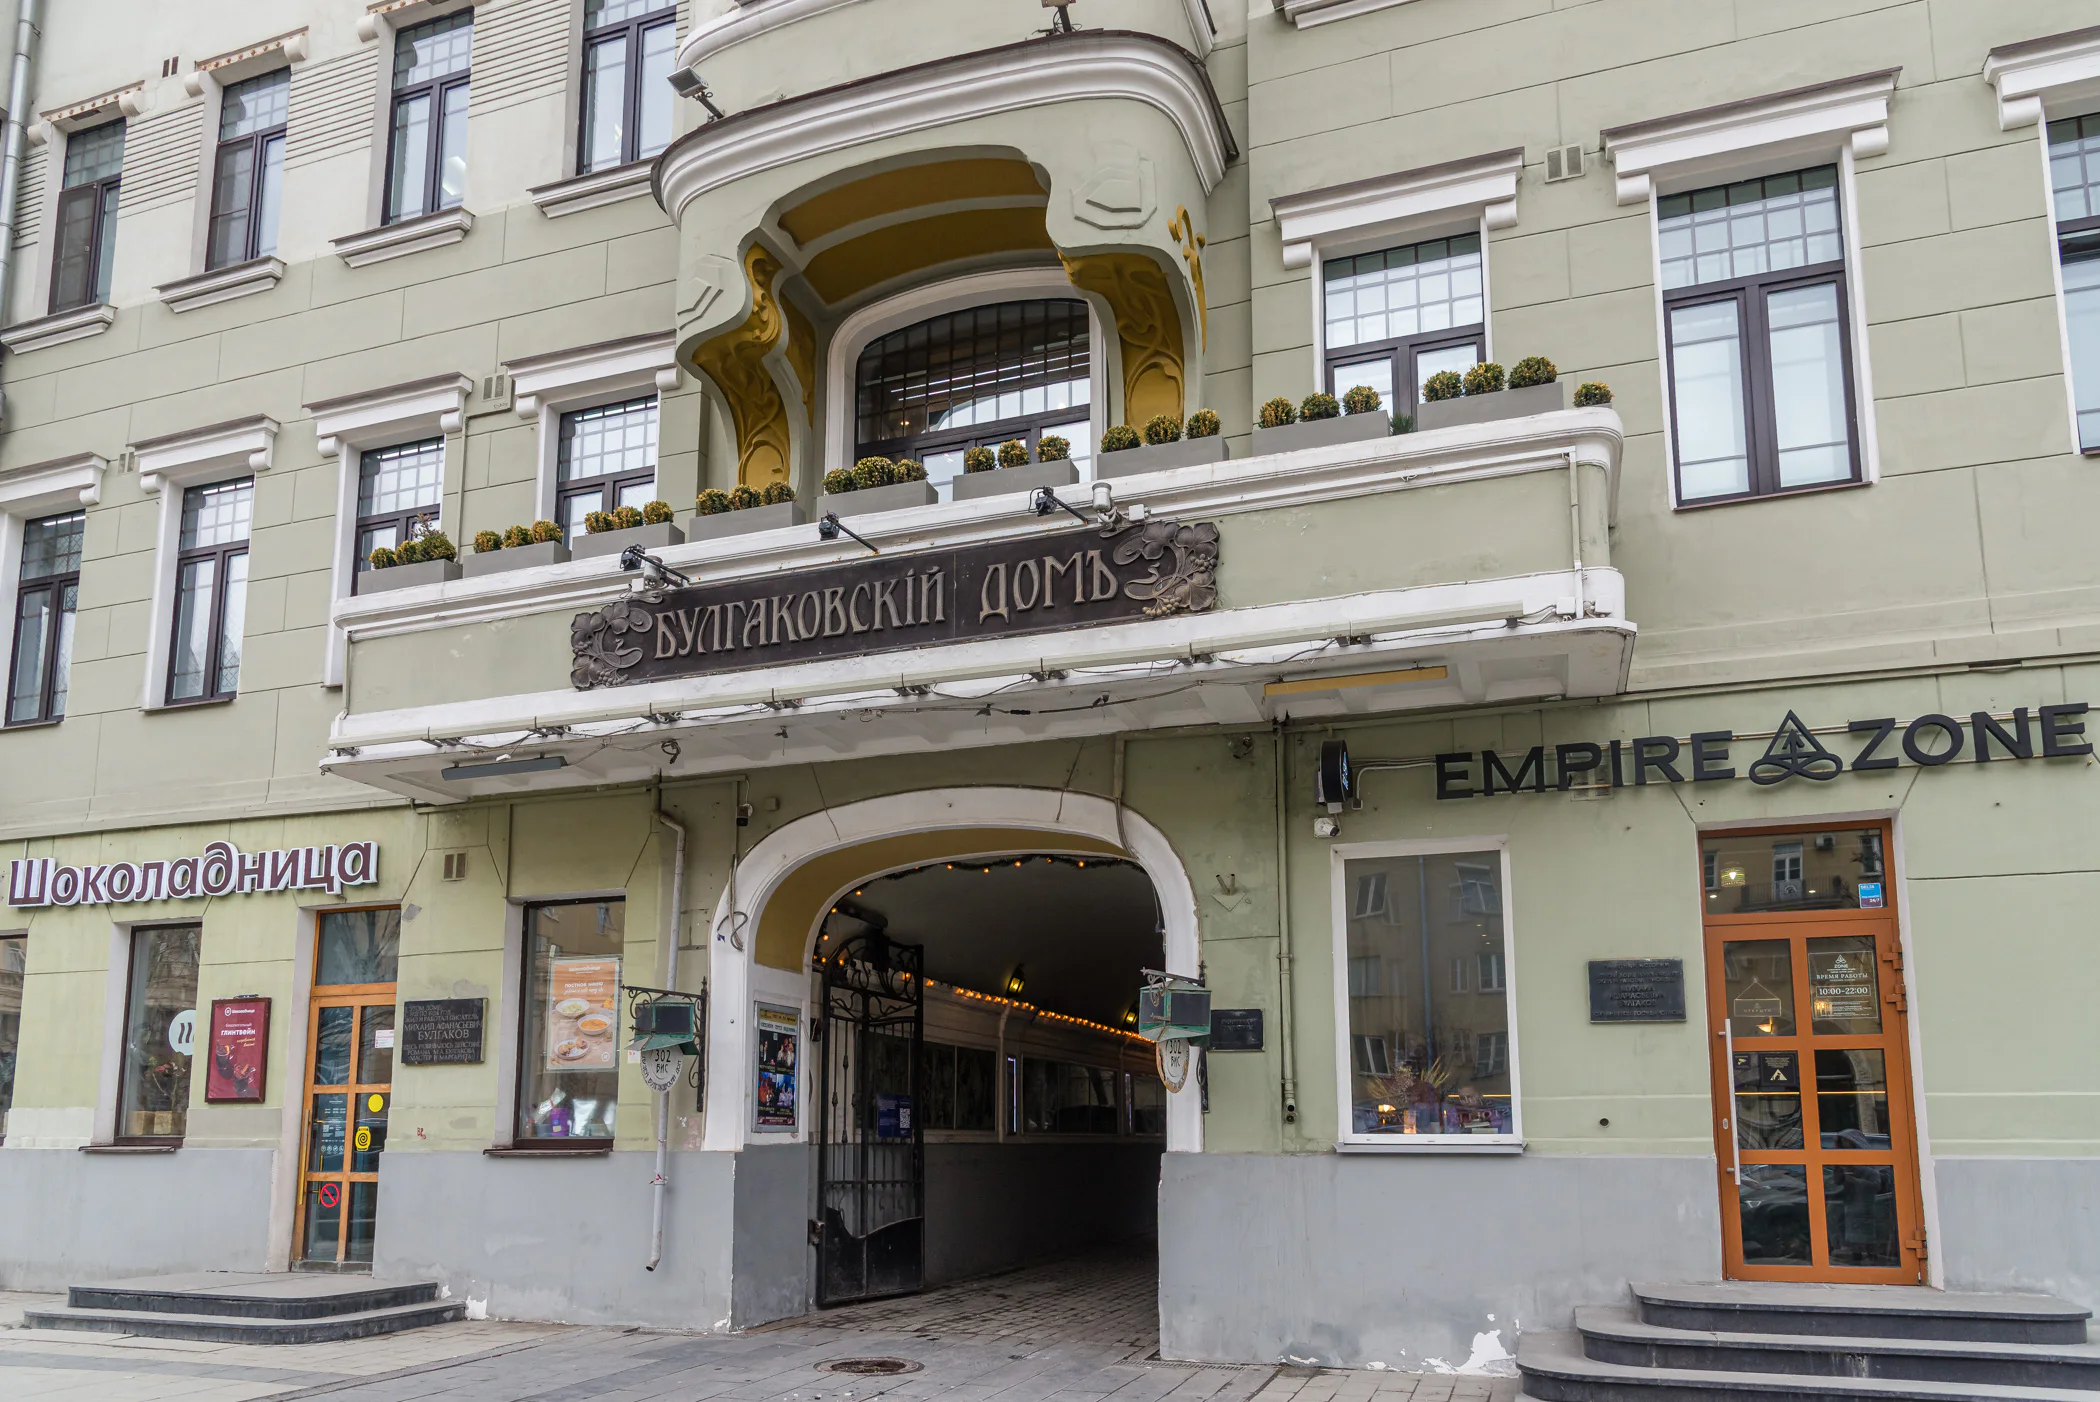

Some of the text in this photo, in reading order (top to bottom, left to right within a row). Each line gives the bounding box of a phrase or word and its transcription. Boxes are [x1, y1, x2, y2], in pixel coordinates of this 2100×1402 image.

[654, 549, 1118, 660] БУЛГАКОВСКІЙ ДОМЪ
[1436, 702, 2093, 799] EMPIRE ZONE
[8, 840, 379, 907] Шоколадница
[1819, 987, 1868, 995] 10:00-22:00
[404, 1022, 435, 1031] МИХАИЛ
[418, 1029, 470, 1040] БУЛГАКОВ
[655, 1049, 671, 1062] 302
[656, 1064, 668, 1073] БИС
